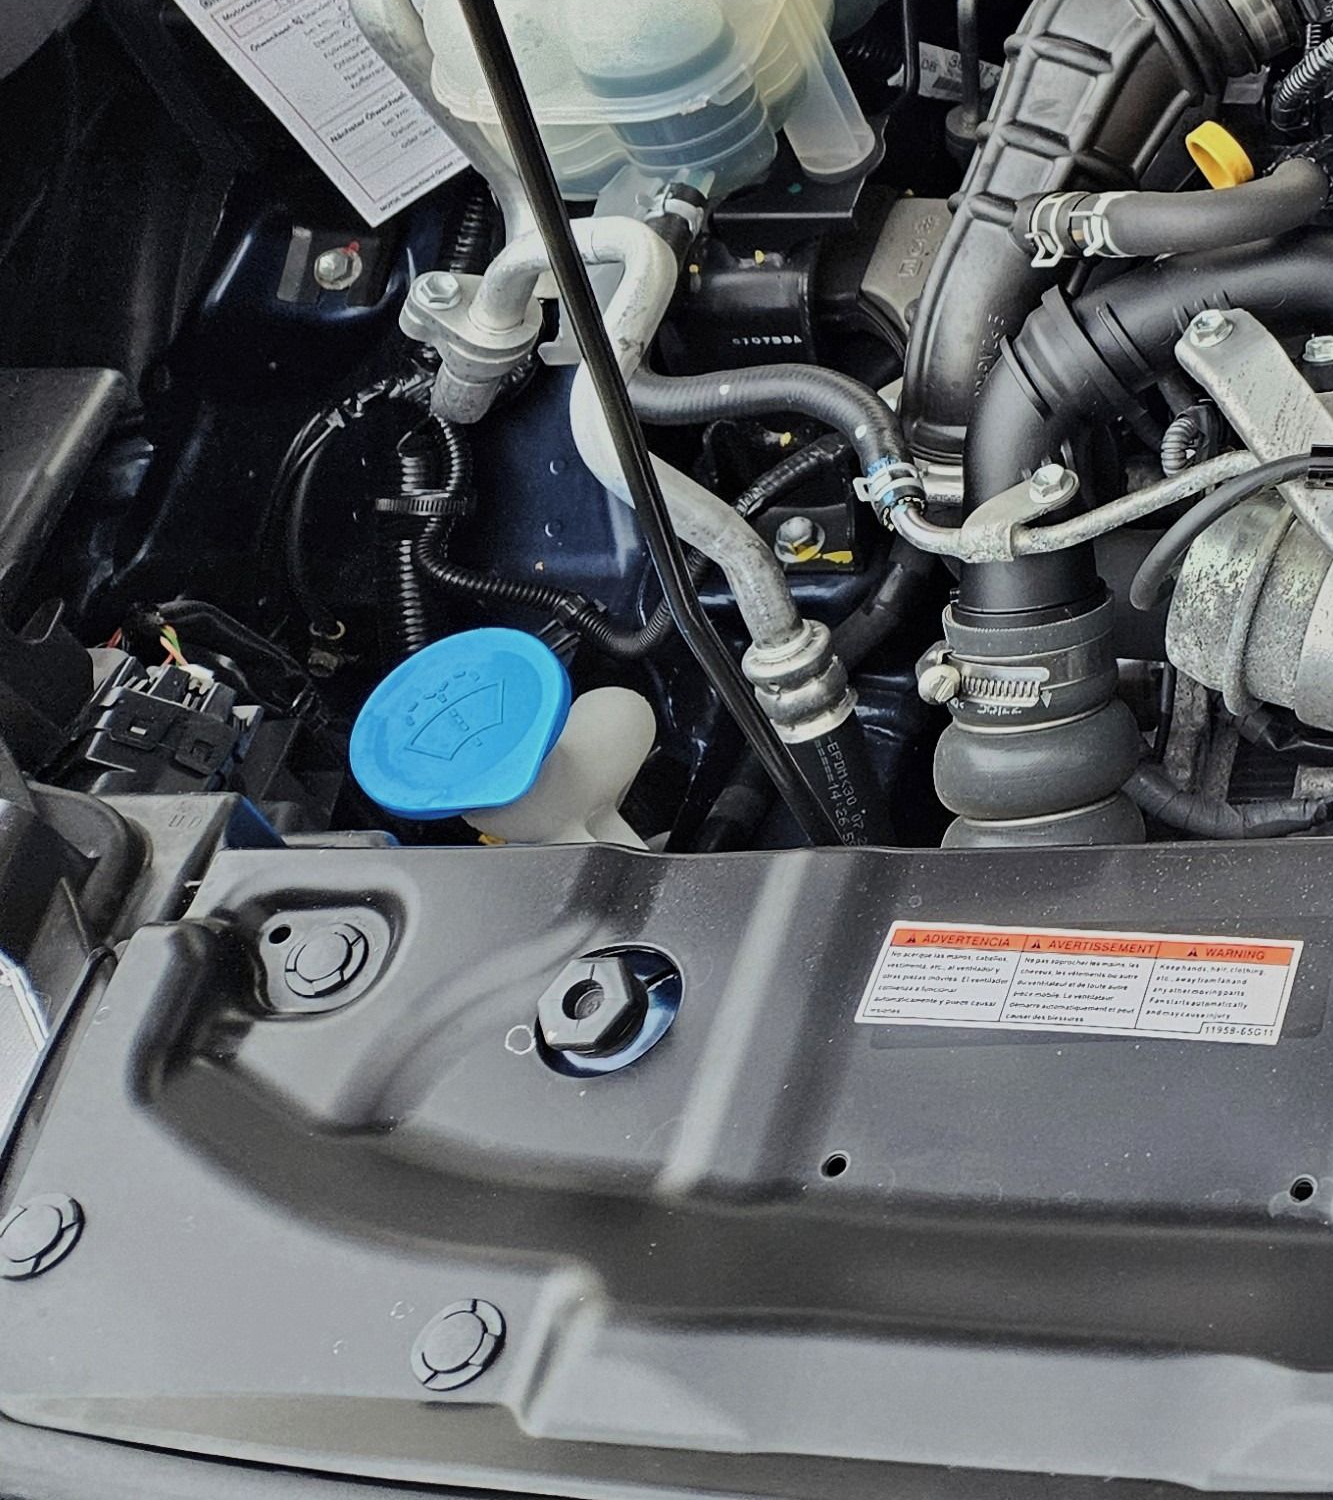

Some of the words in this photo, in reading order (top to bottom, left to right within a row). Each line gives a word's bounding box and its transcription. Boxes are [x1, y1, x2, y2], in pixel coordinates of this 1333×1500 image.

[921, 933, 1011, 946] ADVERTENCIA
[1048, 939, 1154, 953] AVERTISSEMENT
[1204, 947, 1265, 959] WARNING
